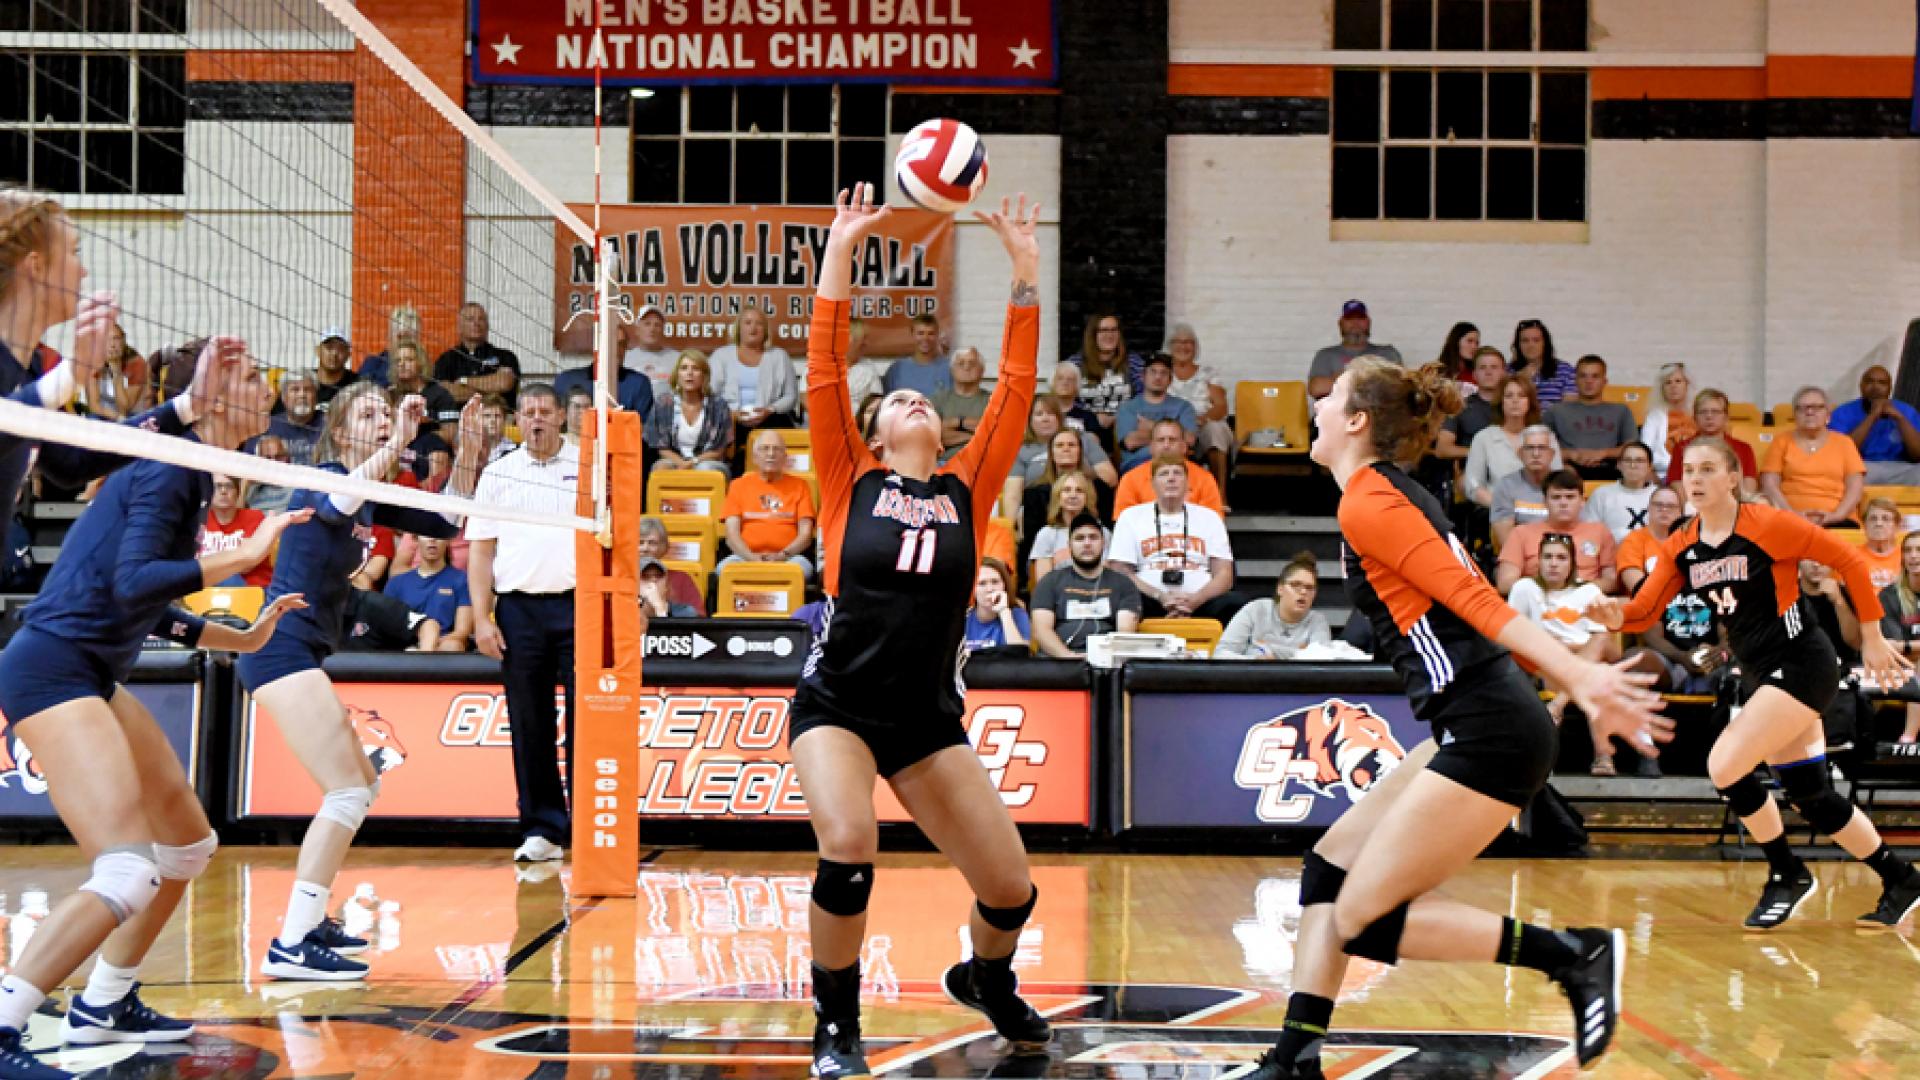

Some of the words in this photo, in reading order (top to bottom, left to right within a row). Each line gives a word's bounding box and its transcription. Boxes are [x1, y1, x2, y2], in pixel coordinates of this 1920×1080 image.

[564, 0, 689, 26] MEN'S
[702, 0, 973, 26] BASKETBALL
[556, 33, 756, 69] NATIONAL
[768, 32, 978, 69] CHAMPION
[678, 220, 937, 288] VOLLEYALL
[896, 529, 937, 573] 11
[1708, 587, 1738, 615] 14
[646, 635, 692, 656] POSS
[1234, 722, 1318, 822] GC
[594, 758, 619, 848] senoh
